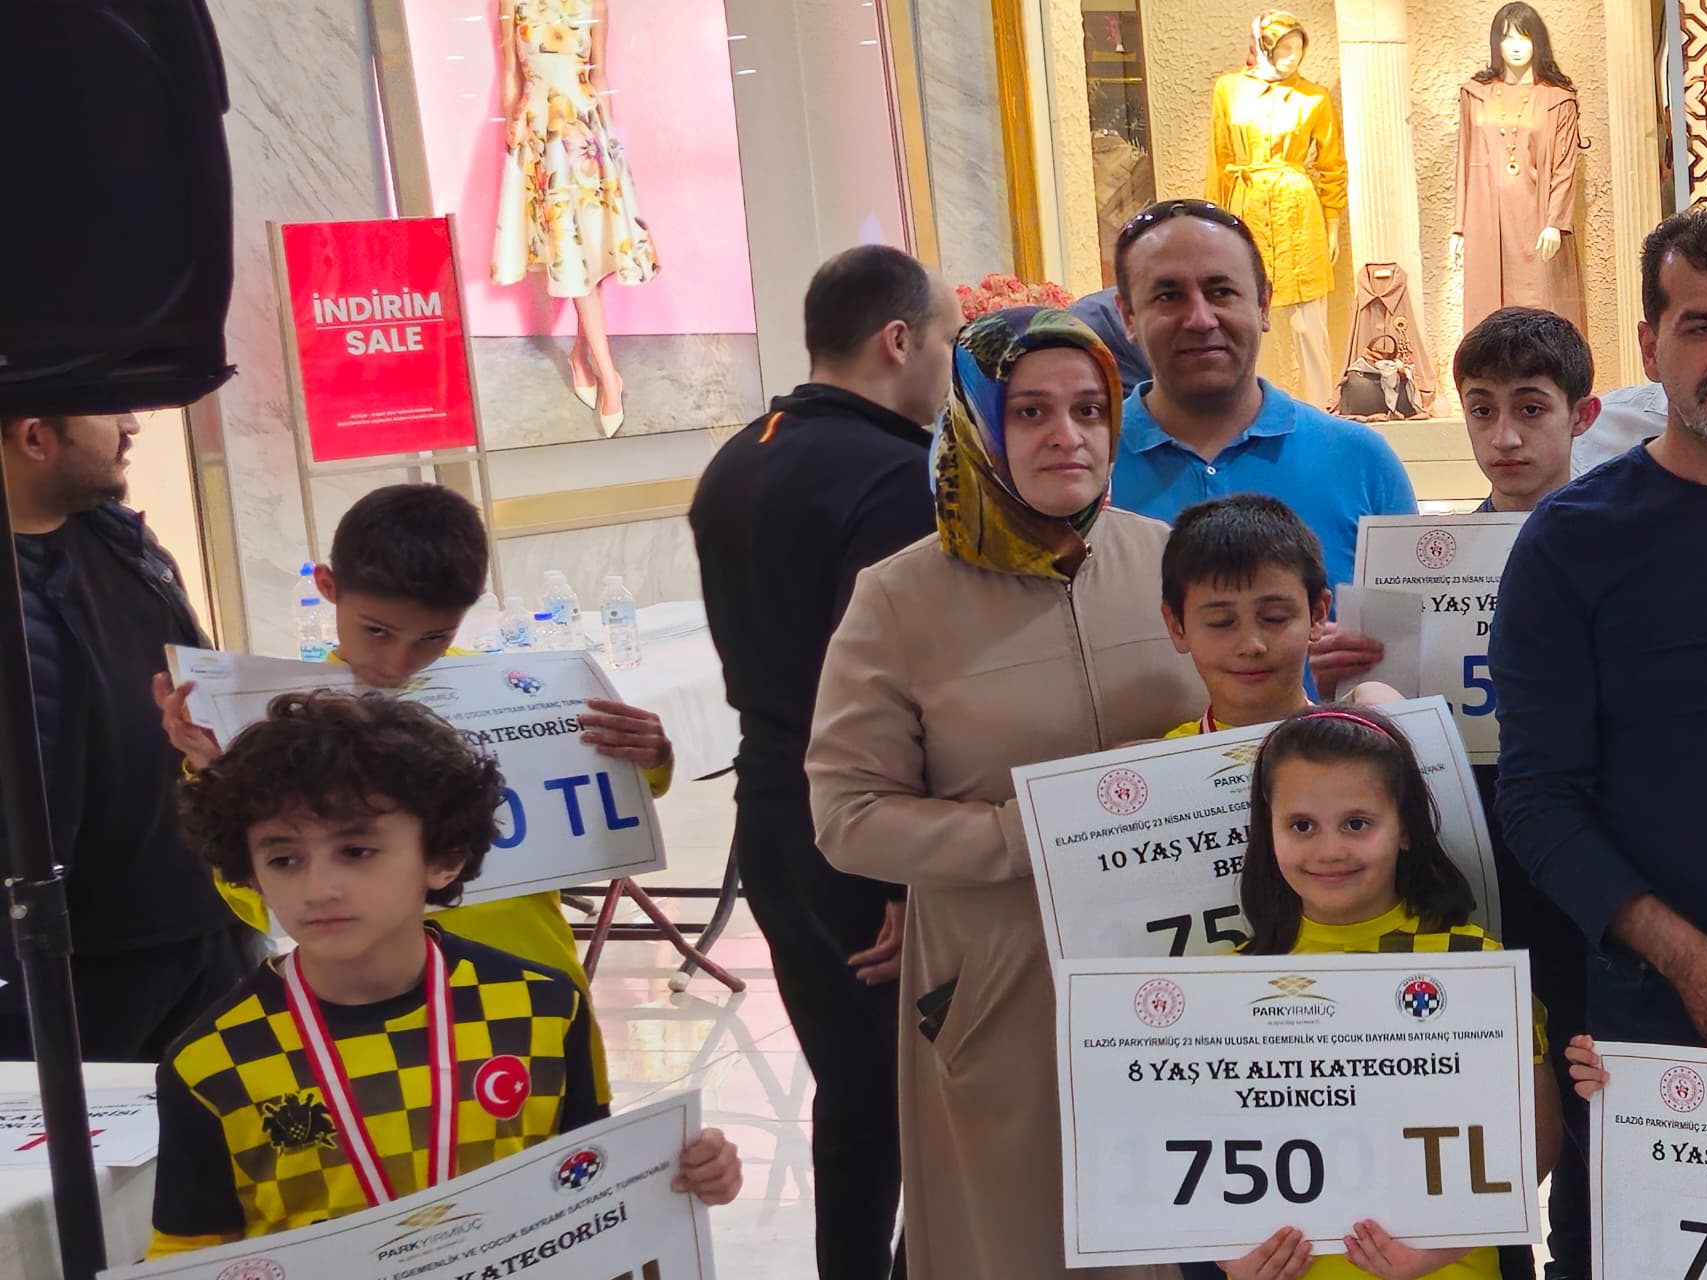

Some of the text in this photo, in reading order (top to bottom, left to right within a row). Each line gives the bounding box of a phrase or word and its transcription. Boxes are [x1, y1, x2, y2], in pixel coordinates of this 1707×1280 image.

[312, 287, 441, 324] İNDİRİM
[346, 326, 423, 356] SALE
[1432, 594, 1470, 615] YAŞ
[544, 771, 640, 836] TL
[1098, 831, 1217, 871] 10 YAŞ VE
[1084, 1037, 1116, 1048] ELAZIĞ
[1183, 1036, 1192, 1046] 23
[1195, 1034, 1222, 1046] NİSAN
[1225, 1035, 1260, 1046] ULUSAL
[1262, 1032, 1315, 1045] EGEMENLİK
[1317, 1034, 1328, 1044] VE
[1330, 1033, 1364, 1045] ÇOCUK
[1366, 1033, 1405, 1043] BAYRAMI
[1408, 1031, 1450, 1043] SATRANÇ
[1452, 1029, 1503, 1040] TURNUVASI
[1129, 1053, 1460, 1085] 8 YAŞ VE ALTI KATEGORİSİ
[1236, 1085, 1356, 1109] YEDİNCİSİ
[1615, 1115, 1643, 1126] ELAZIĞ
[1166, 1126, 1512, 1205] 750 TL
[1652, 1140, 1665, 1161] 8
